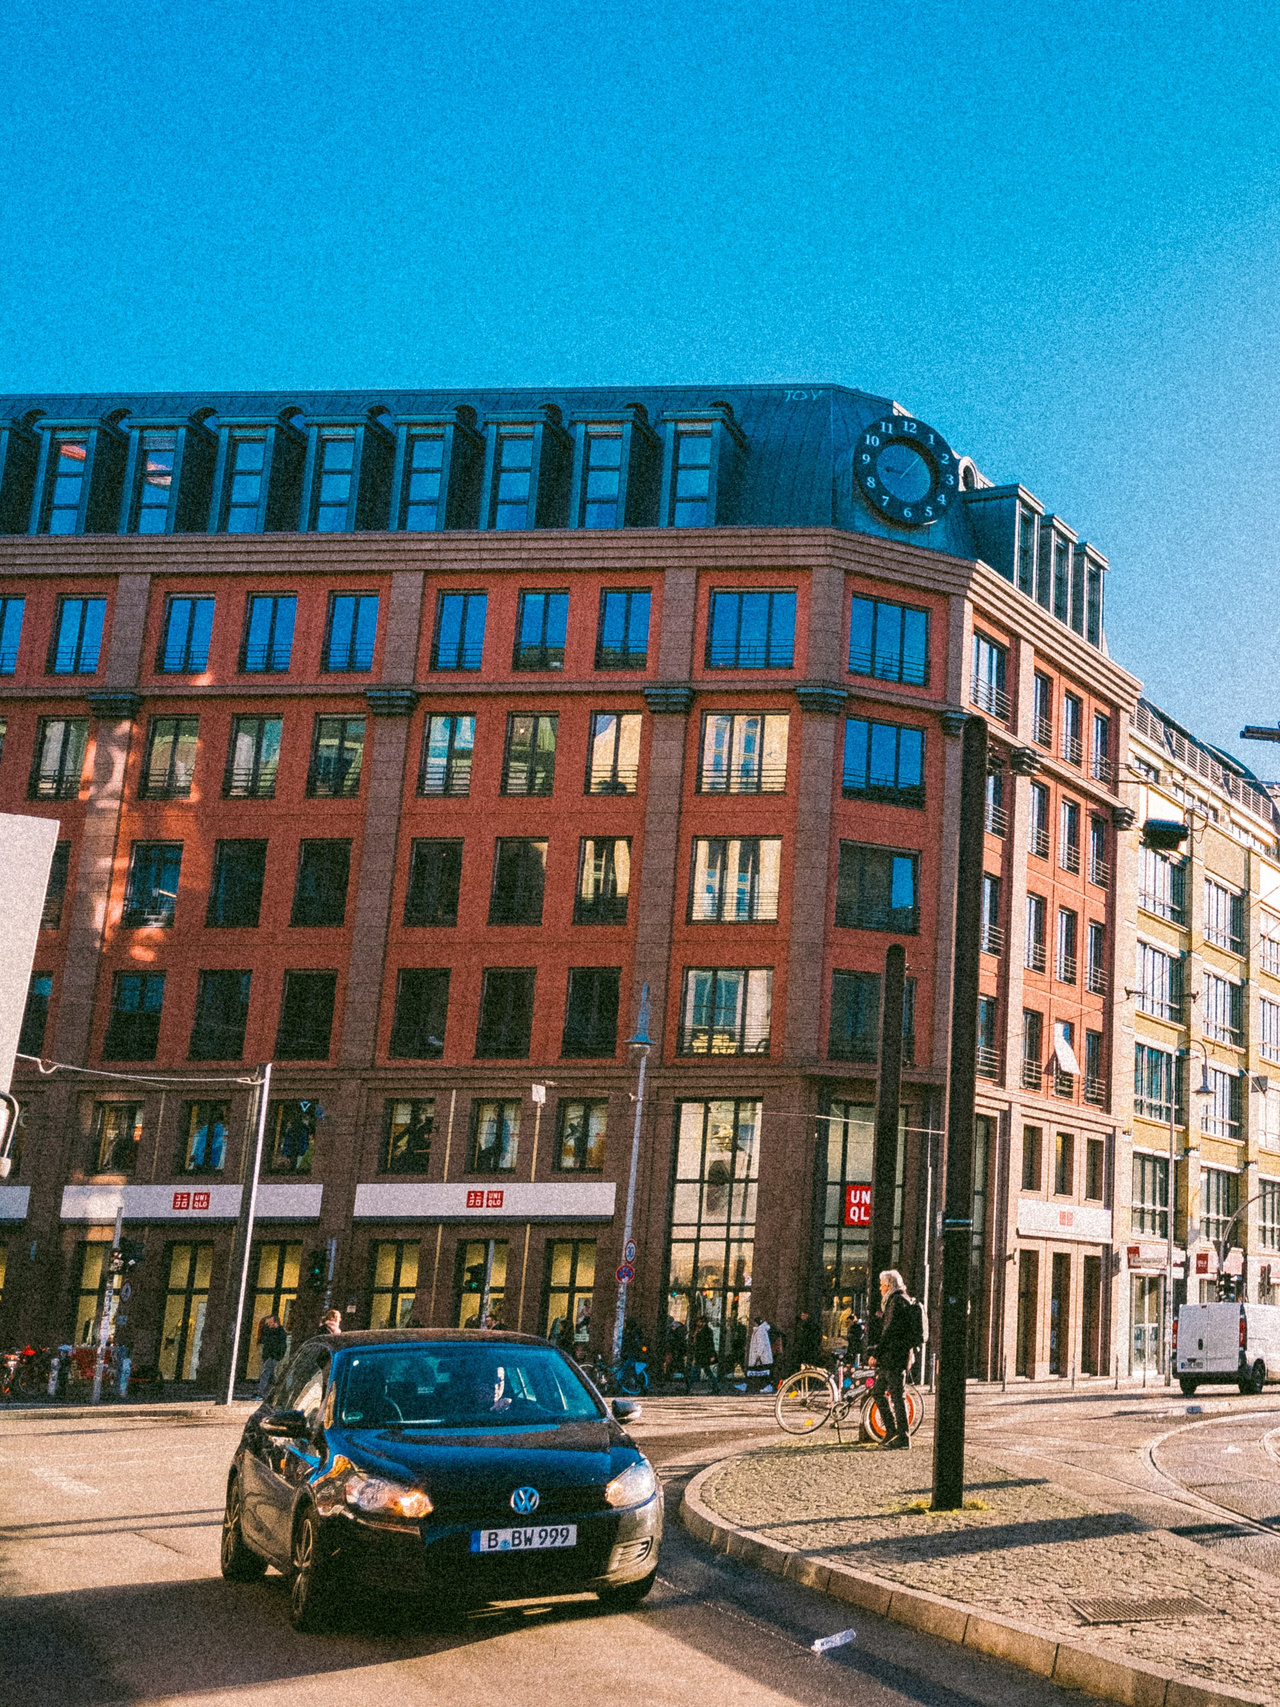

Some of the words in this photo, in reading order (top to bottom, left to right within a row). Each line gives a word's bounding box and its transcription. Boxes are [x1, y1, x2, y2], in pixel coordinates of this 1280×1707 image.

[879, 421, 895, 434] 11
[902, 420, 917, 434] 12
[864, 434, 880, 448] 10
[928, 433, 935, 446] 1
[862, 453, 871, 465] 9
[942, 453, 950, 465] 2
[866, 476, 876, 488] 8
[946, 473, 954, 486] 3
[881, 495, 890, 507] 7
[937, 493, 947, 506] 4
[903, 506, 912, 519] 6
[925, 505, 933, 518] 5
[850, 1190, 871, 1205] UN
[850, 1206, 870, 1222] QL
[487, 1531, 499, 1549] B
[512, 1530, 534, 1548] BW
[538, 1527, 570, 1546] 999
